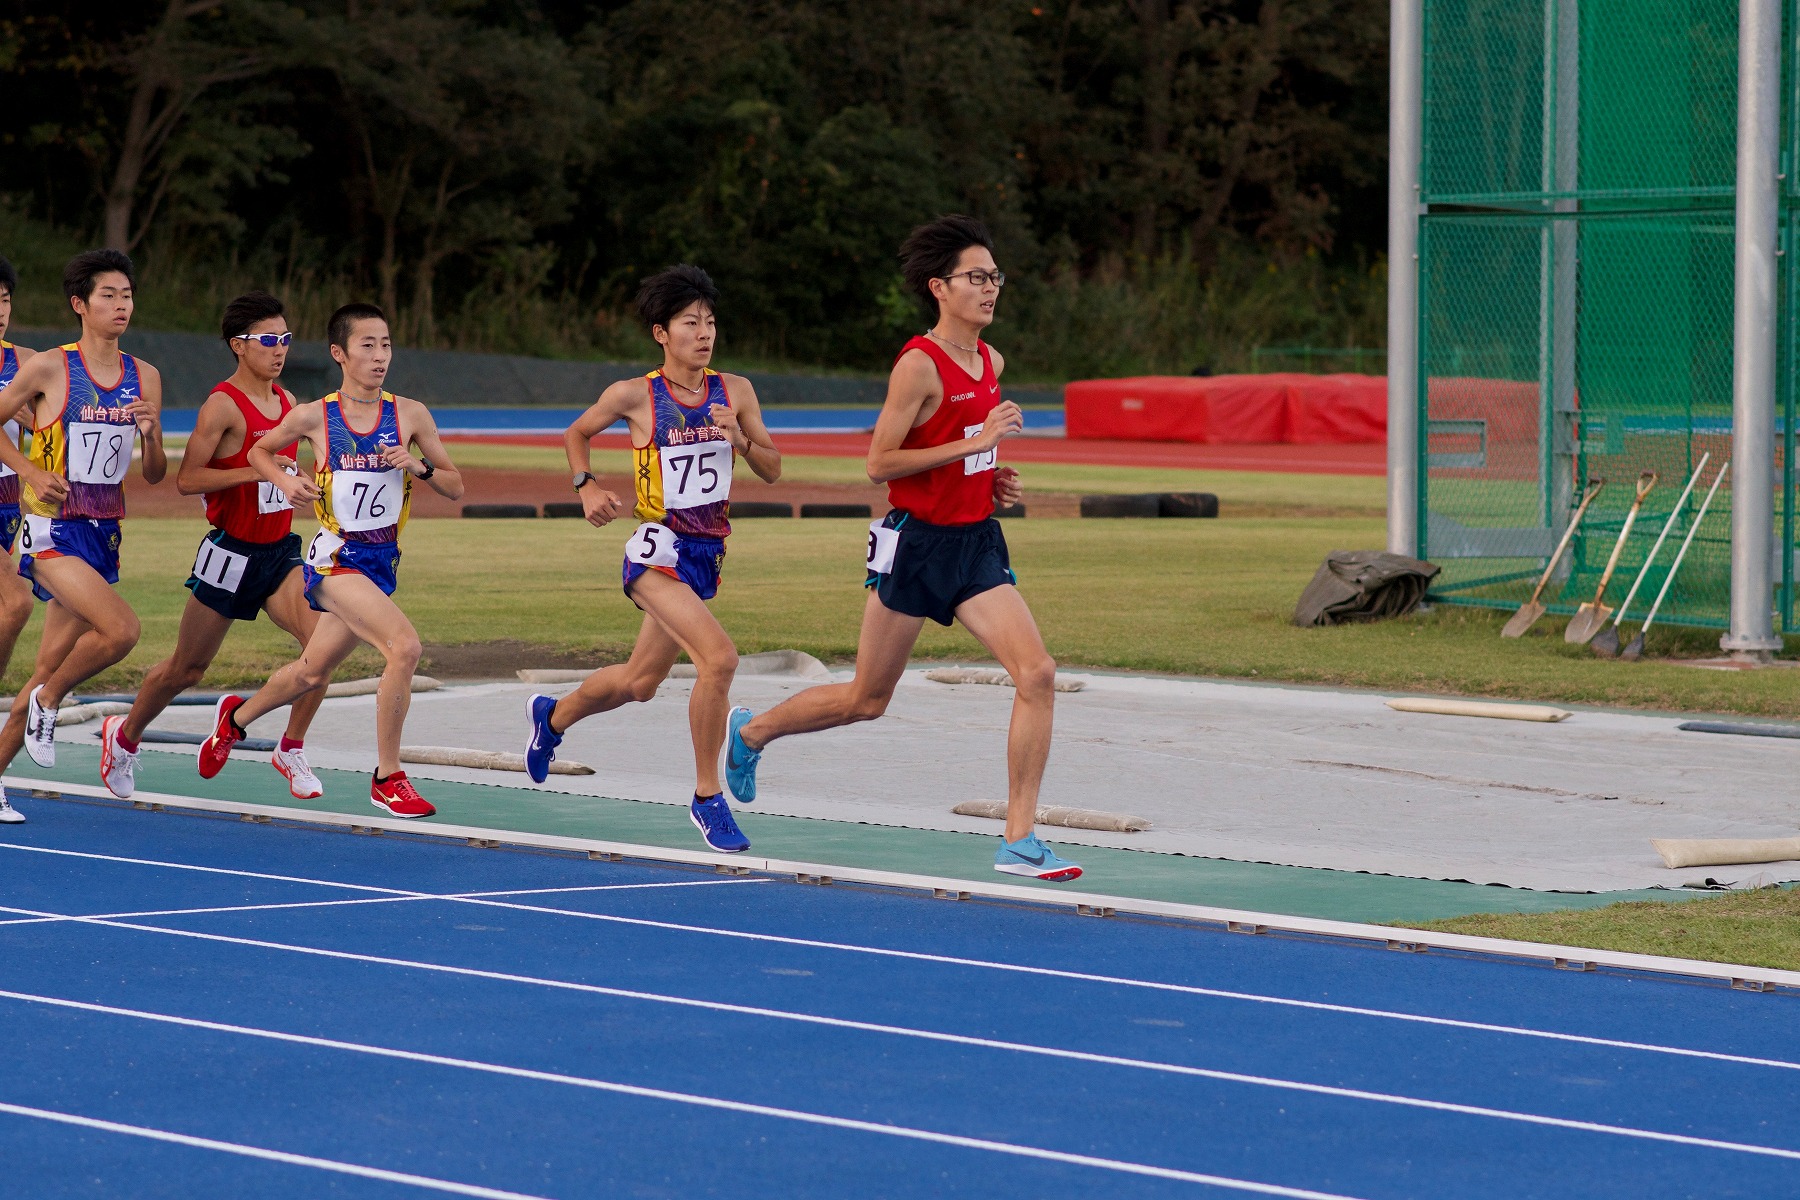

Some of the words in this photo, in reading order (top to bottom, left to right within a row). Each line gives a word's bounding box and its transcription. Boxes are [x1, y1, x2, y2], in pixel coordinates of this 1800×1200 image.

[668, 425, 723, 445] 仙台育英
[82, 431, 123, 478] 78
[669, 452, 718, 494] 75
[353, 482, 386, 519] 76
[22, 519, 32, 549] 8
[309, 531, 323, 560] 6
[640, 527, 660, 559] 5
[201, 547, 232, 584] 11
